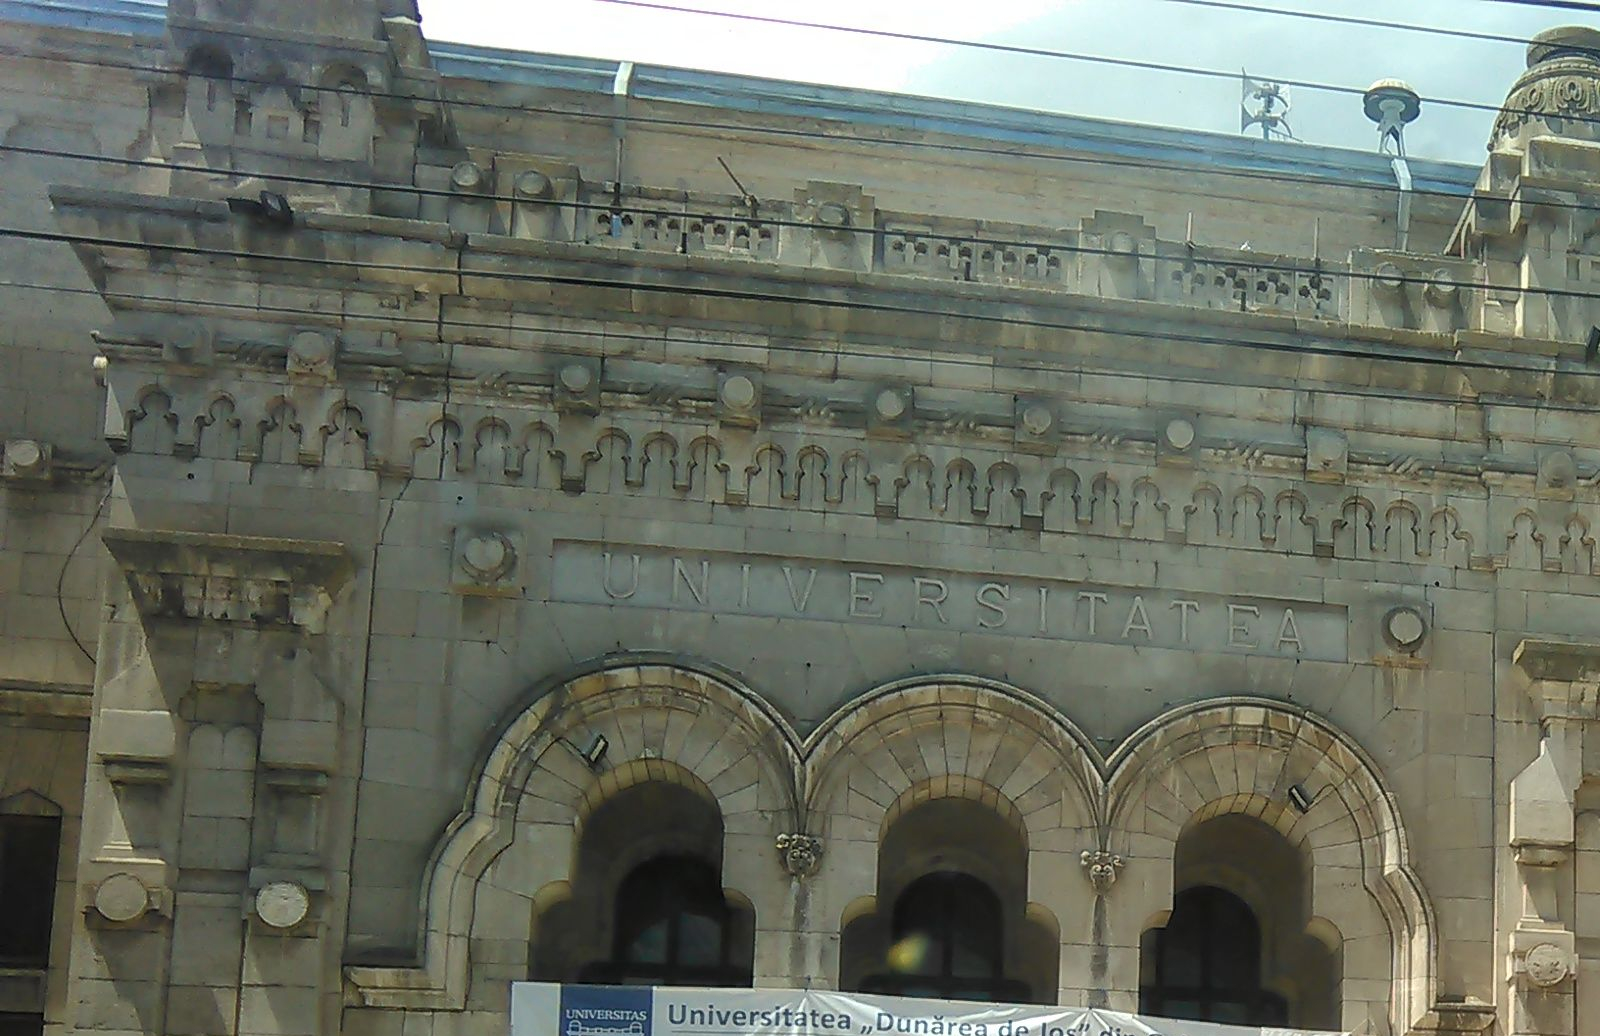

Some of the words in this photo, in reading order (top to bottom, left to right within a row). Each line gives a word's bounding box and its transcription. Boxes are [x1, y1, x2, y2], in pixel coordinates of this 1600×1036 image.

[600, 551, 1305, 653] UNIVERSITATEA
[565, 1008, 648, 1022] UNIVERSITAS
[667, 1003, 852, 1031] Universitatea
